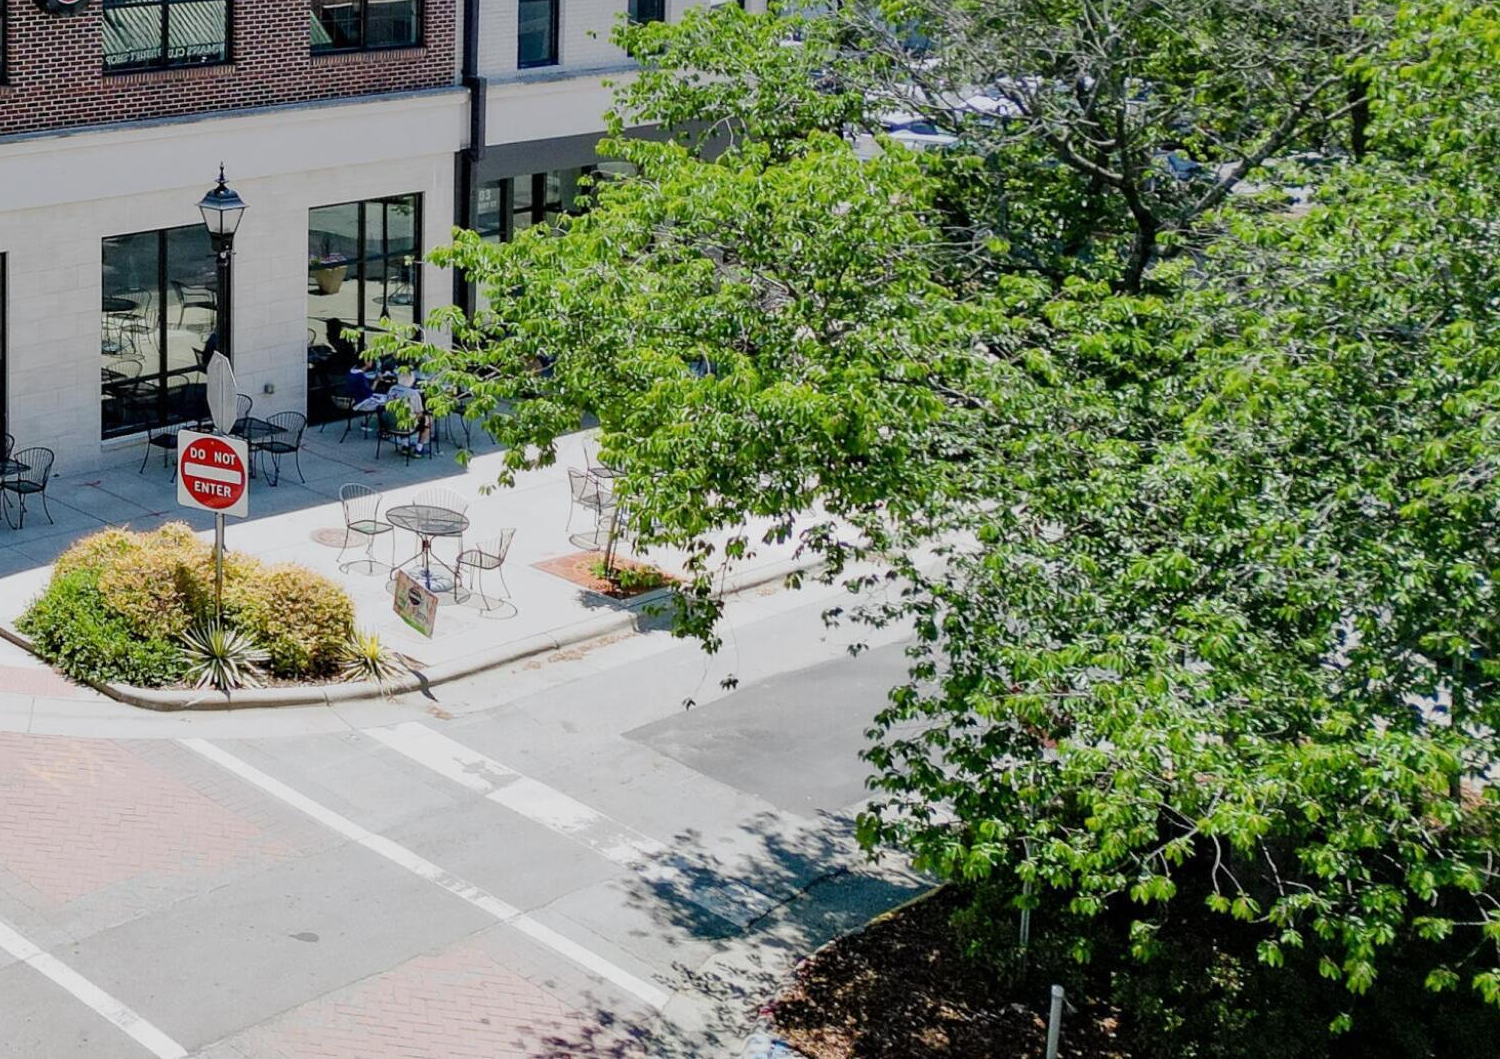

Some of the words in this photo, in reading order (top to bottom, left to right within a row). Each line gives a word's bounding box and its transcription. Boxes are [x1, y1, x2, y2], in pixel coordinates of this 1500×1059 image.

[189, 446, 206, 460] DO
[214, 451, 236, 466] NOT
[194, 480, 232, 498] ENTER
